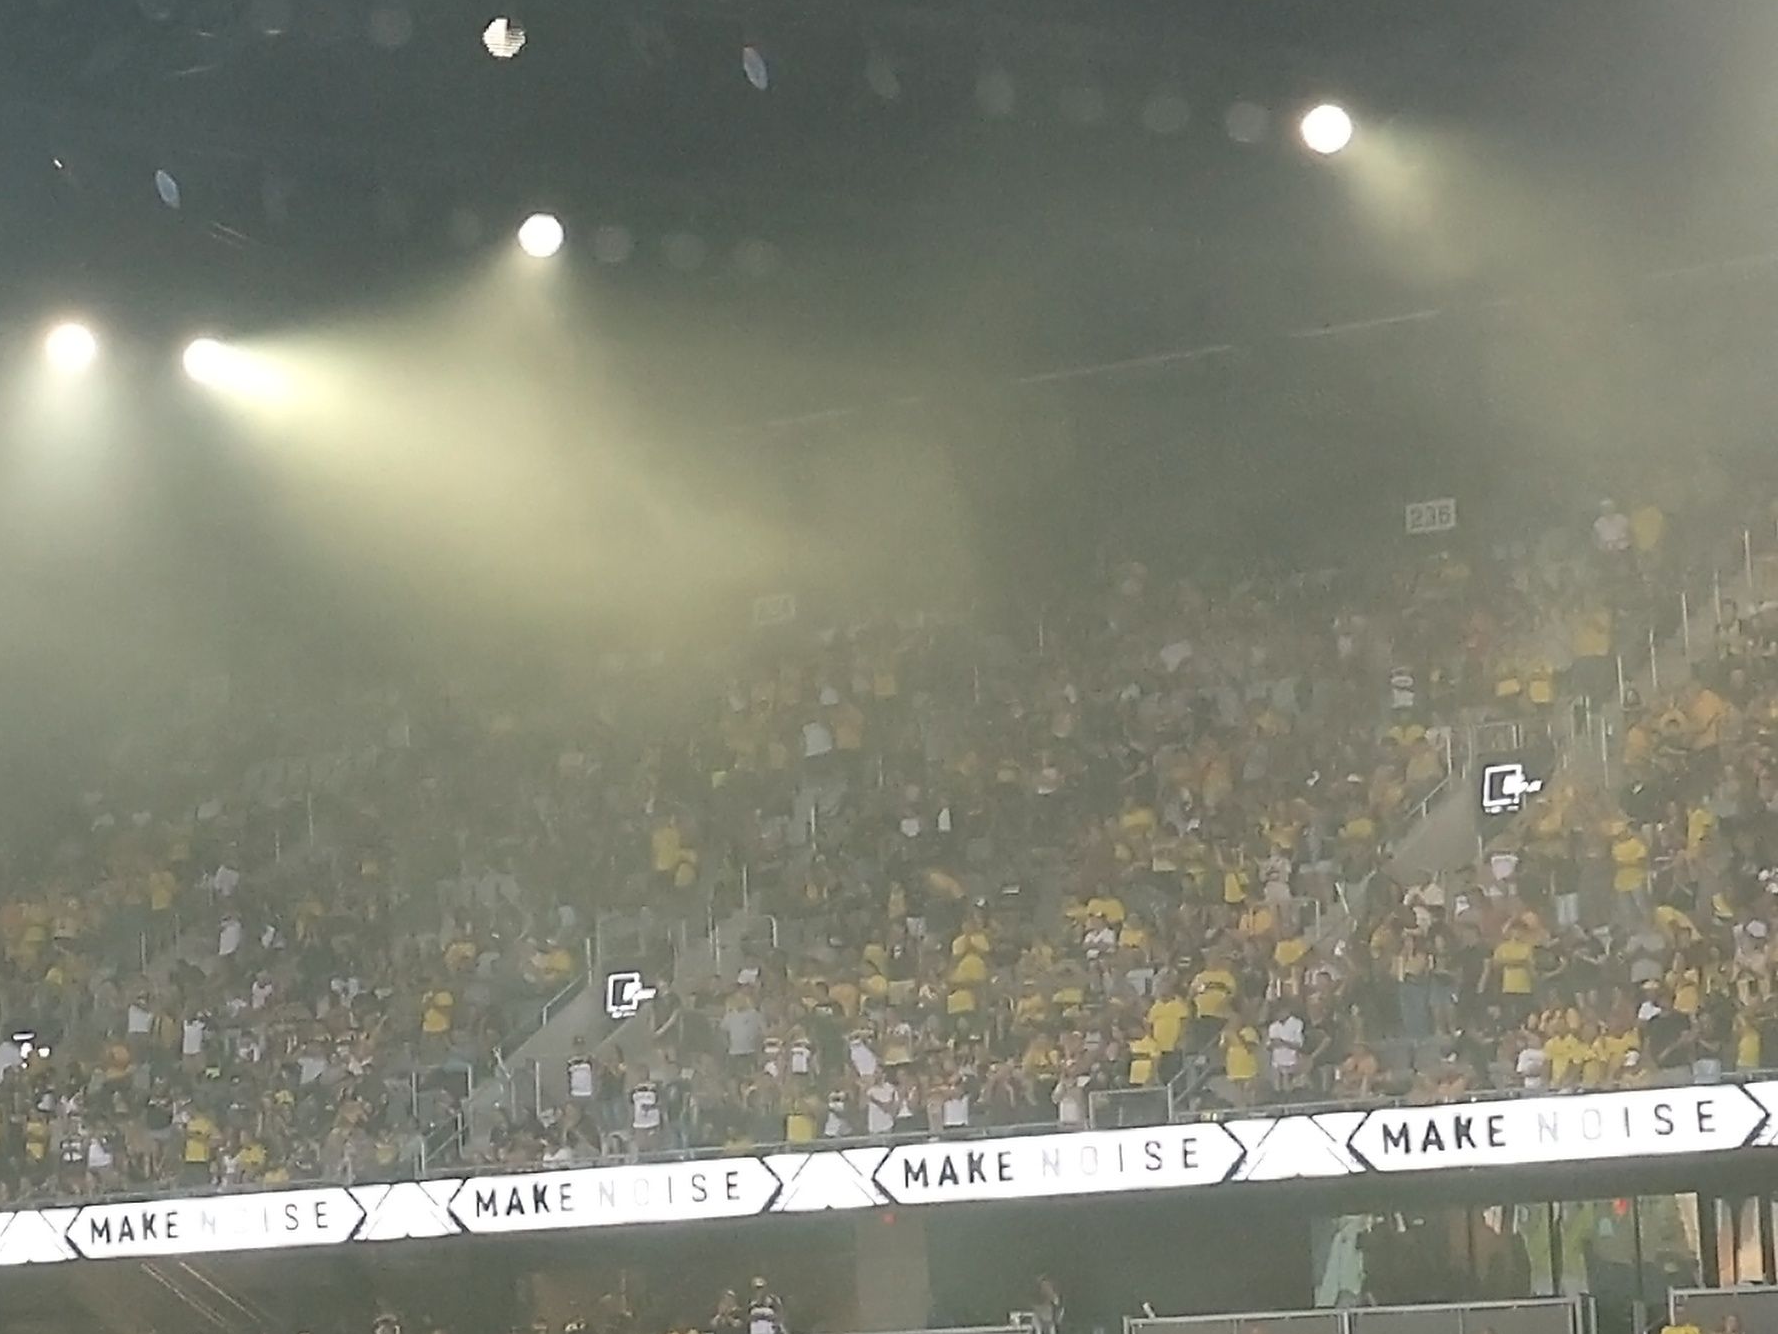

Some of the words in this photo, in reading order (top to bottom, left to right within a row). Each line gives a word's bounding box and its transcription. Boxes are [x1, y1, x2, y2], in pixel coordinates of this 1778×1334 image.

[1382, 1114, 1506, 1156] MAKE
[903, 1147, 1014, 1188] MAKE
[475, 1181, 575, 1217] MAKE
[90, 1210, 179, 1245] MAKE
